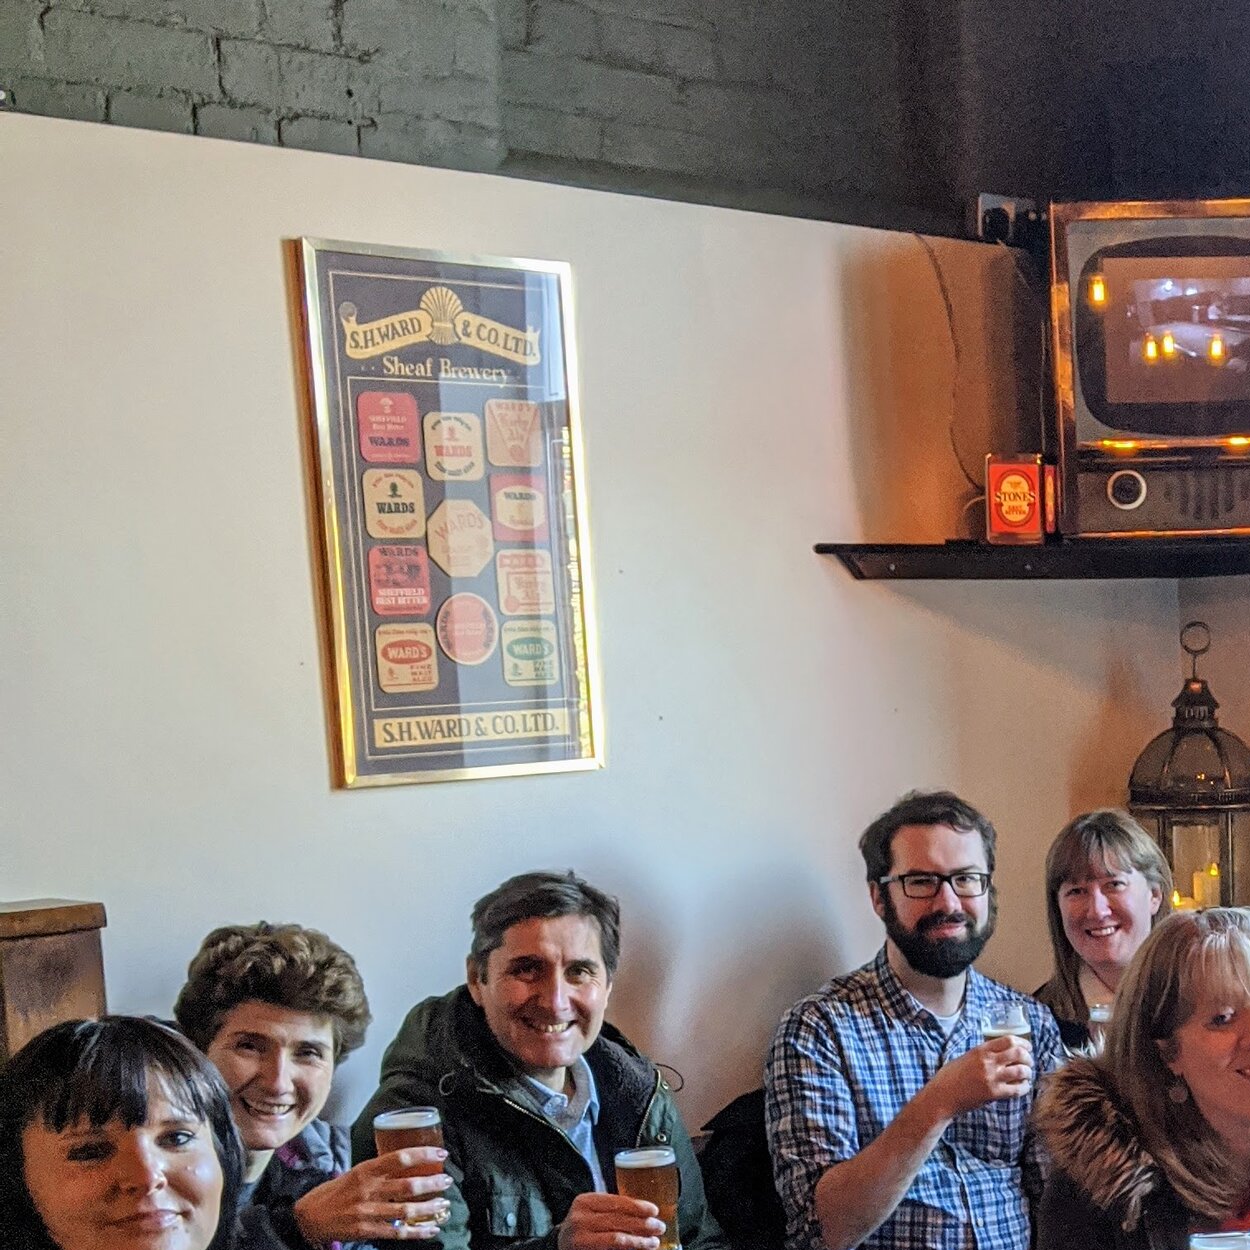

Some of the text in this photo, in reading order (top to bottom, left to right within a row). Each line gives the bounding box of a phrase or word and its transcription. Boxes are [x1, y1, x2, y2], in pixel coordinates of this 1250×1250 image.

[461, 319, 472, 338] &
[382, 355, 507, 388] Sheaf Brewery
[367, 435, 411, 447] WARDS
[995, 491, 1036, 502] STONES
[376, 502, 415, 514] WARDS
[475, 716, 487, 736] &
